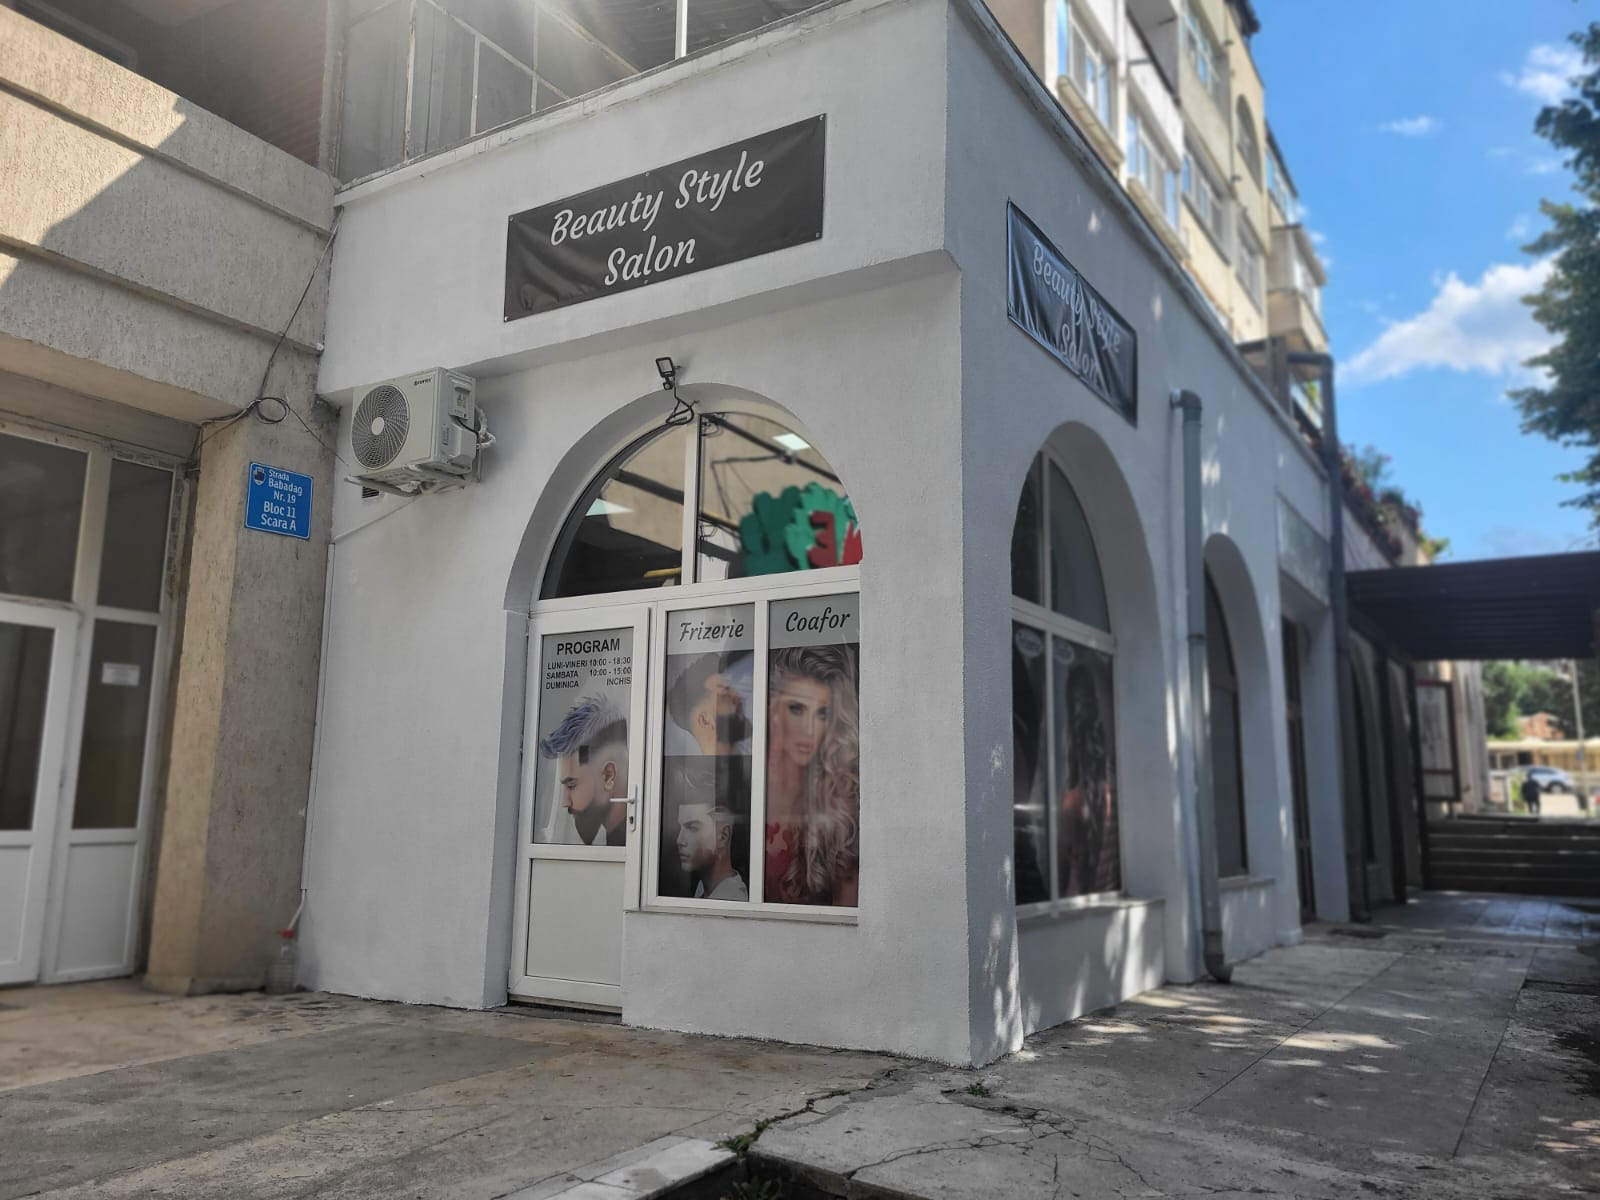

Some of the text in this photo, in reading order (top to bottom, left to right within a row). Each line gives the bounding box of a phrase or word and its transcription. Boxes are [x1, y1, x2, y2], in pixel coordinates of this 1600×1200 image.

[550, 150, 765, 246] Beauty Style
[604, 235, 696, 286] Salon
[268, 469, 290, 482] Strada
[268, 478, 303, 497] Babadag
[273, 490, 297, 504] Nr. 19
[263, 501, 297, 518] Bloc 11
[260, 513, 297, 531] Scara A
[785, 606, 851, 633] Coafor
[679, 618, 745, 642] Frizerie
[556, 638, 620, 655] PROGRAM
[547, 659, 588, 670] LUNI-VINERI
[589, 658, 607, 667] 10:00
[546, 670, 579, 680] SAMBATA
[589, 668, 607, 677] 10:00
[613, 666, 632, 675] 15:00
[545, 677, 631, 690] DUMINICA INCHIS
